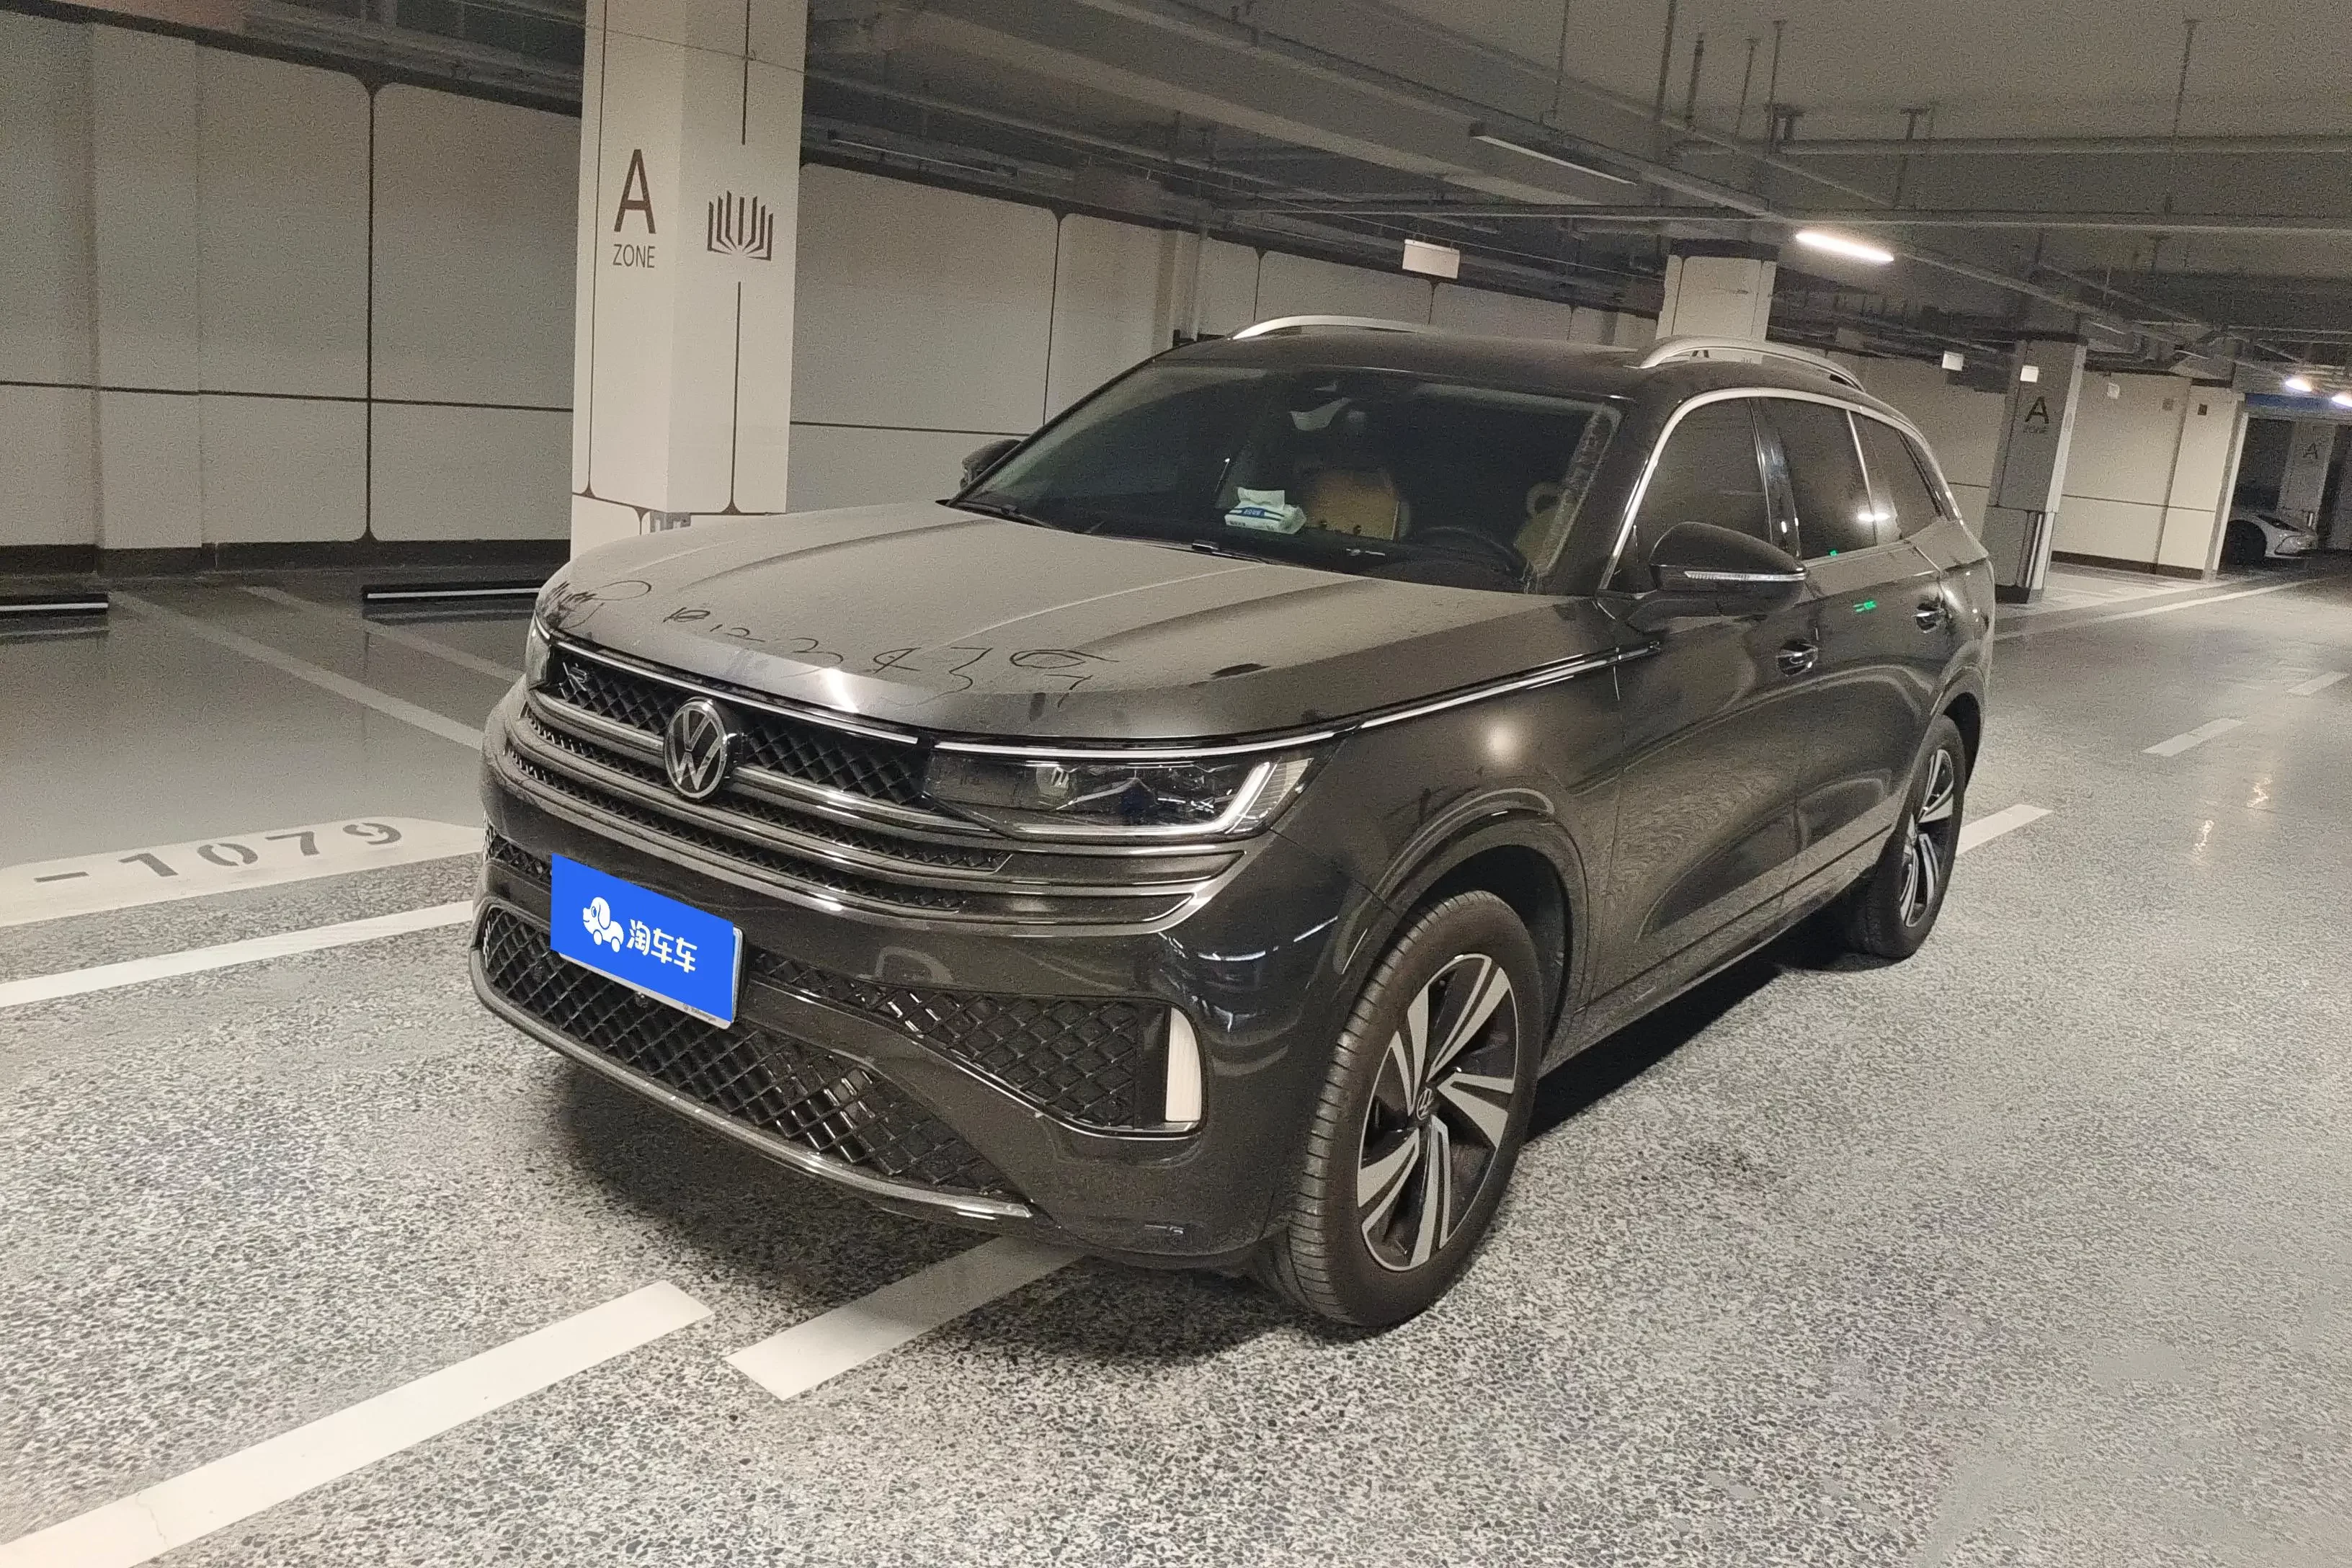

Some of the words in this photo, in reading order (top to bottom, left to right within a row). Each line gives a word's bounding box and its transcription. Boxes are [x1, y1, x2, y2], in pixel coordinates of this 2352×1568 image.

[614, 148, 656, 234] A
[612, 243, 656, 270] ZONE
[2025, 396, 2049, 424] A
